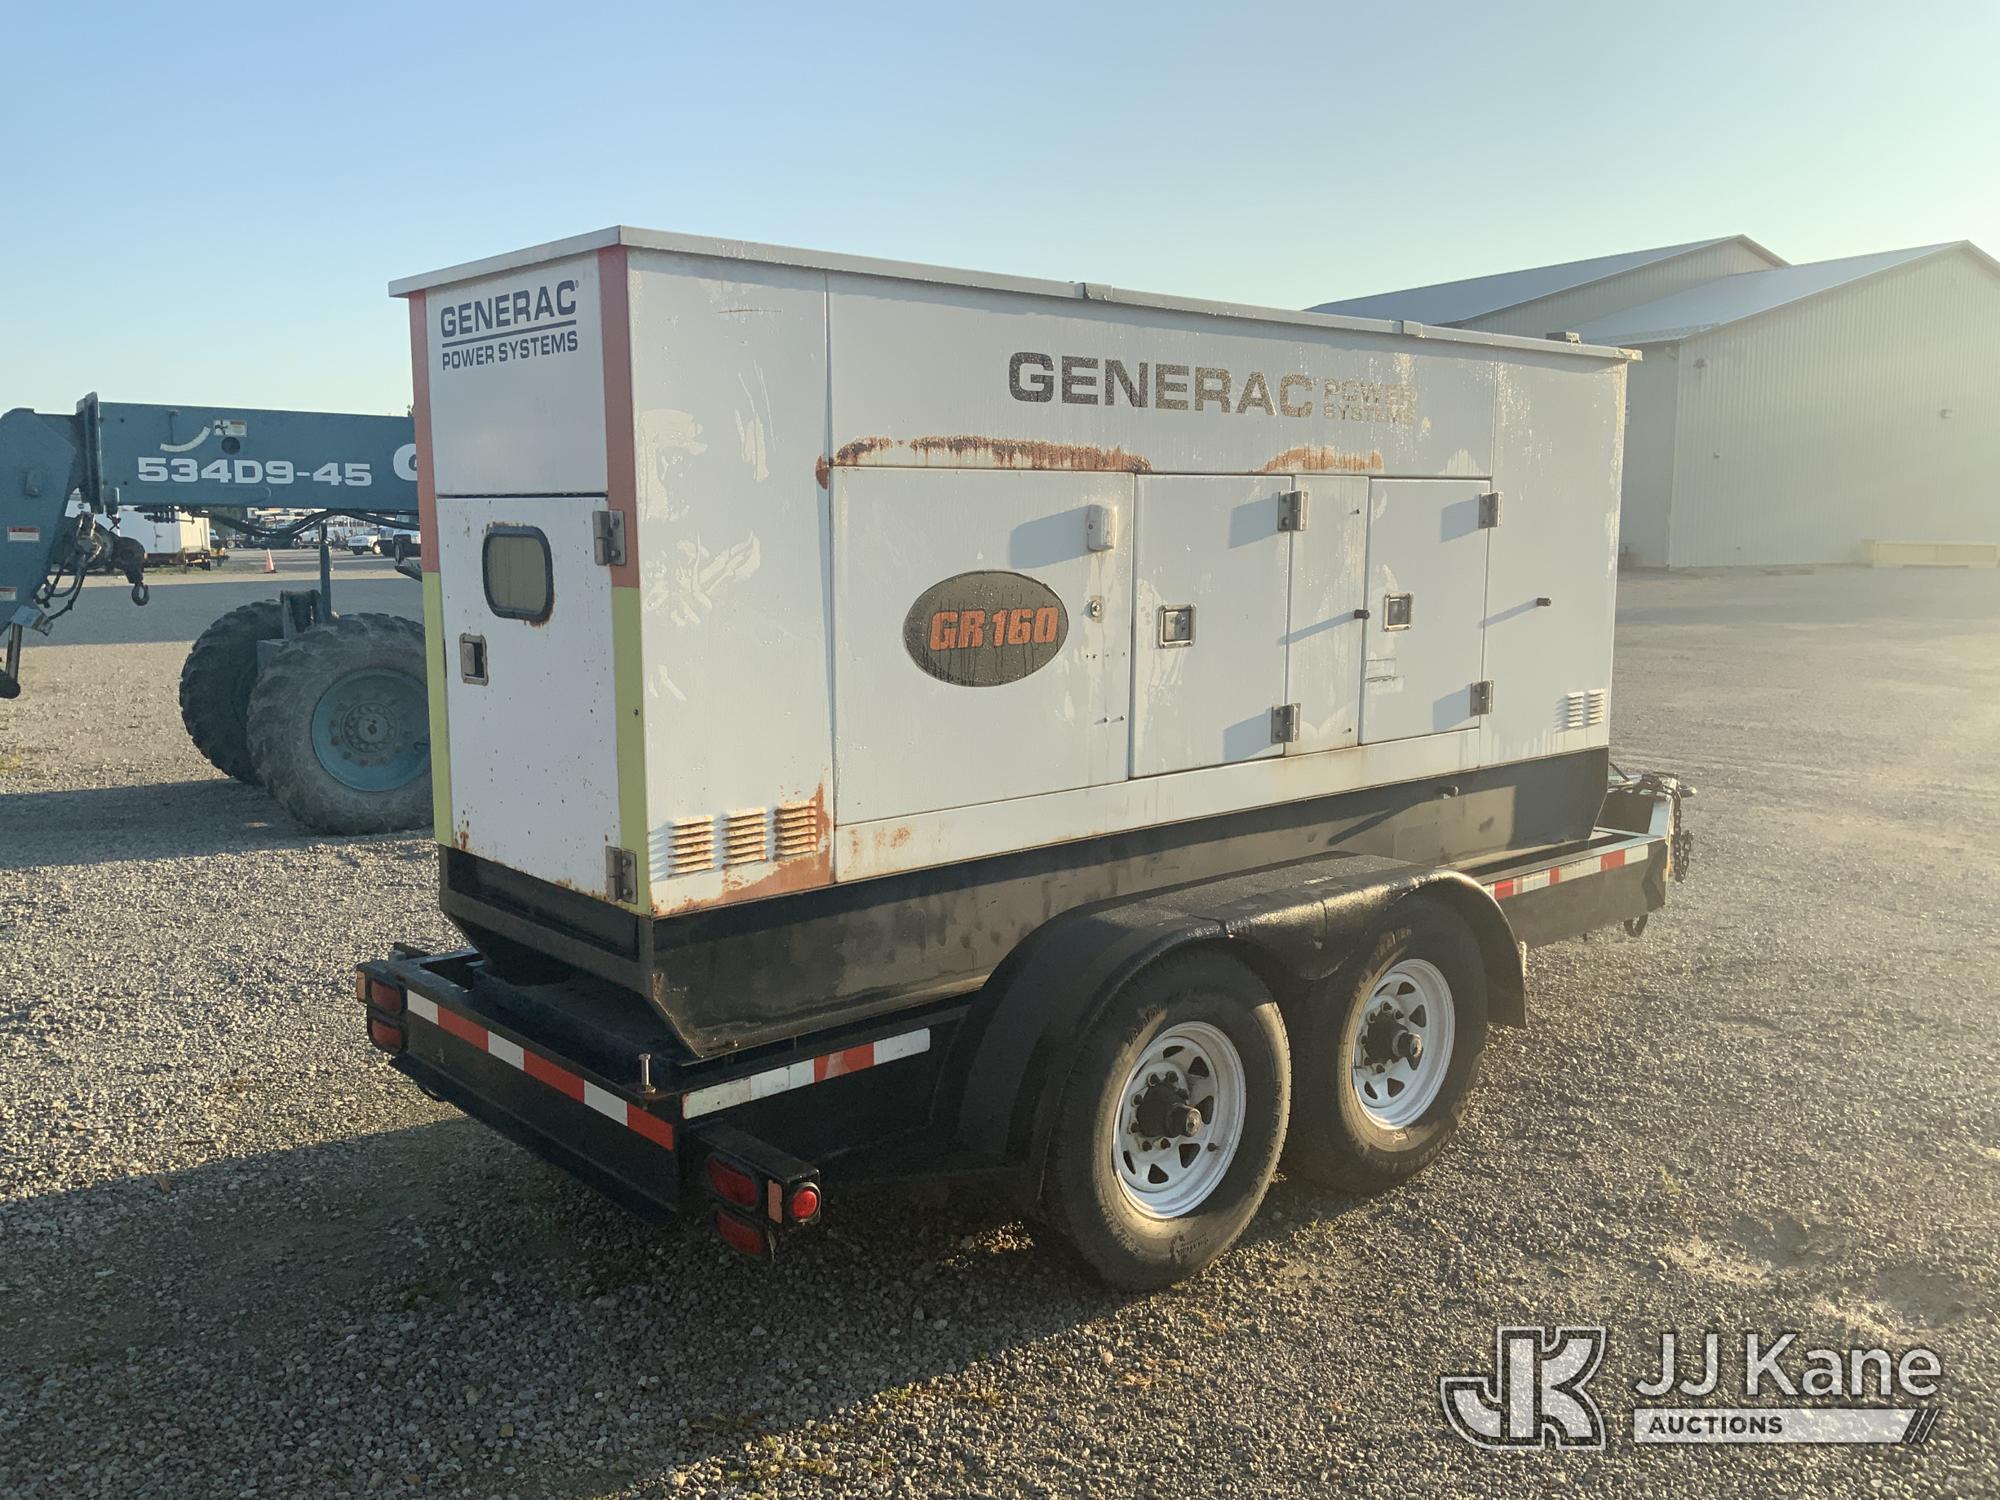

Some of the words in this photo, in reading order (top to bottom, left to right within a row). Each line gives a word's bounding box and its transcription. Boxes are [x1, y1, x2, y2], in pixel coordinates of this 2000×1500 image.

[442, 345, 495, 371] POWER
[498, 330, 579, 362] SYSTEMS
[1008, 351, 1313, 418] GENERAC
[137, 456, 372, 487] 534D9-45
